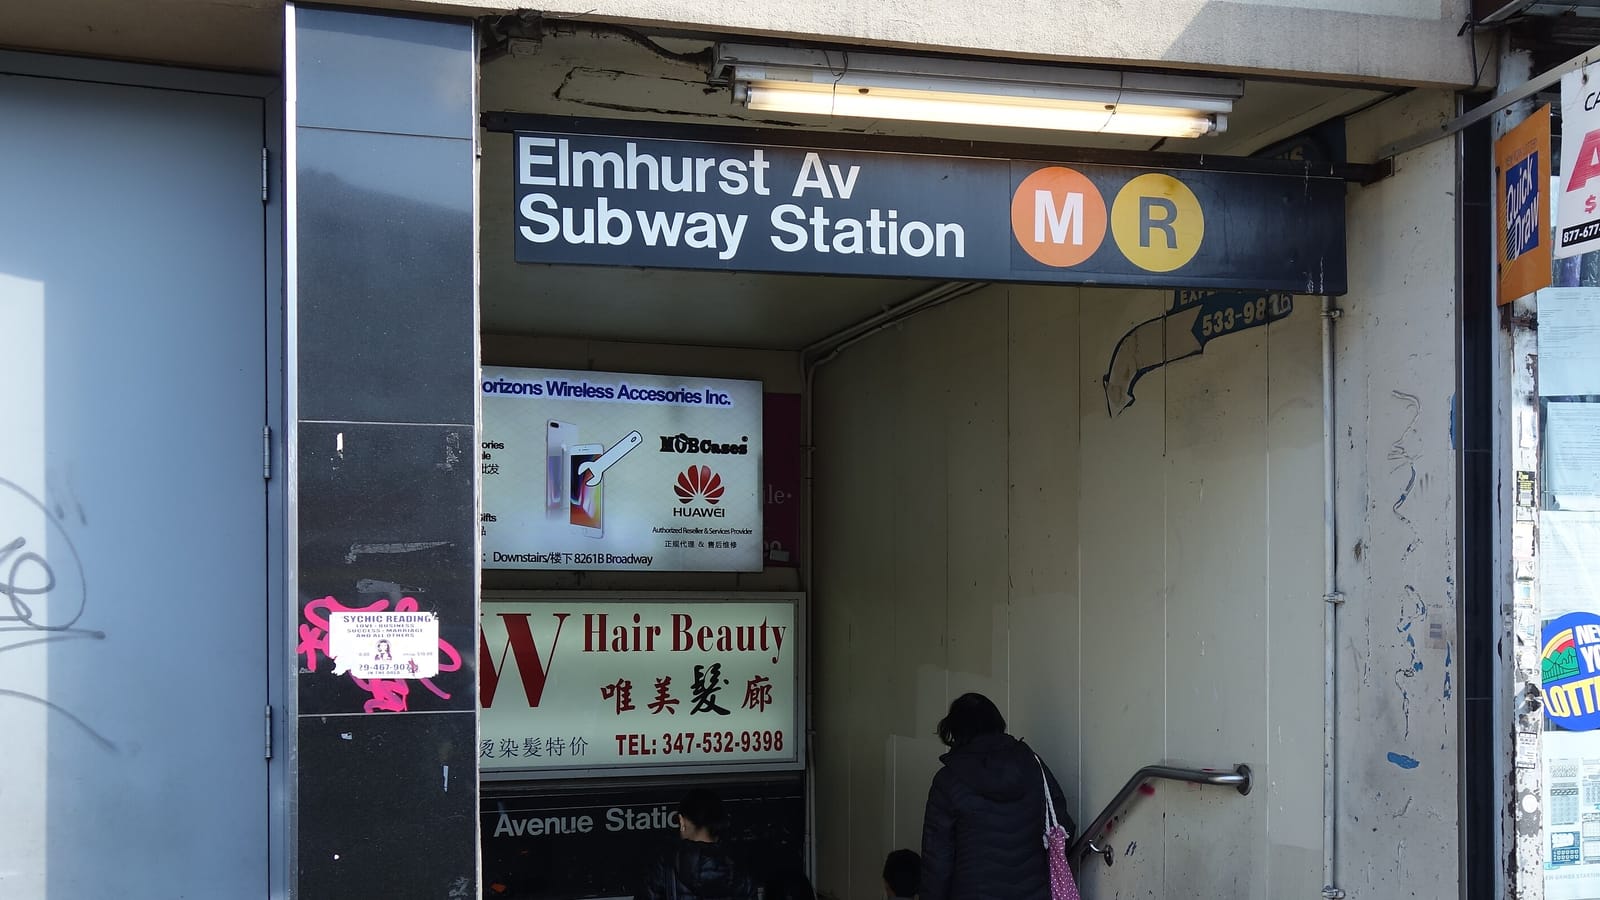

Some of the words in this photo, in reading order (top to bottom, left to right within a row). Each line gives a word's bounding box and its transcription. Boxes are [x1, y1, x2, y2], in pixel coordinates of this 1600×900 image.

[519, 136, 770, 195] Elmhurst
[792, 152, 861, 199] Av
[1507, 153, 1533, 231] Quick
[519, 193, 748, 260] Subway
[770, 204, 965, 258] Station
[1034, 189, 1084, 246] M
[1138, 196, 1178, 249] R
[1514, 192, 1540, 261] Draw
[482, 378, 543, 396] orizons
[546, 380, 614, 399] Wireless
[617, 384, 702, 404] Accesories
[705, 389, 731, 405] Inc.
[482, 440, 504, 450] ories
[482, 451, 491, 460] le
[481, 513, 497, 522] ifts
[673, 507, 725, 518] HUAWEI
[574, 553, 604, 564] 8261B
[606, 553, 653, 566] Broadway
[386, 615, 431, 623] READING
[582, 613, 661, 652] Hair
[670, 614, 786, 664] Beauty
[1575, 624, 1600, 646] NE
[600, 662, 773, 716] 唯美髮廊
[1541, 675, 1600, 717] LOTT
[615, 734, 656, 756] TEL:
[663, 730, 783, 754] 347-532-9398
[493, 813, 593, 838] Avenue
